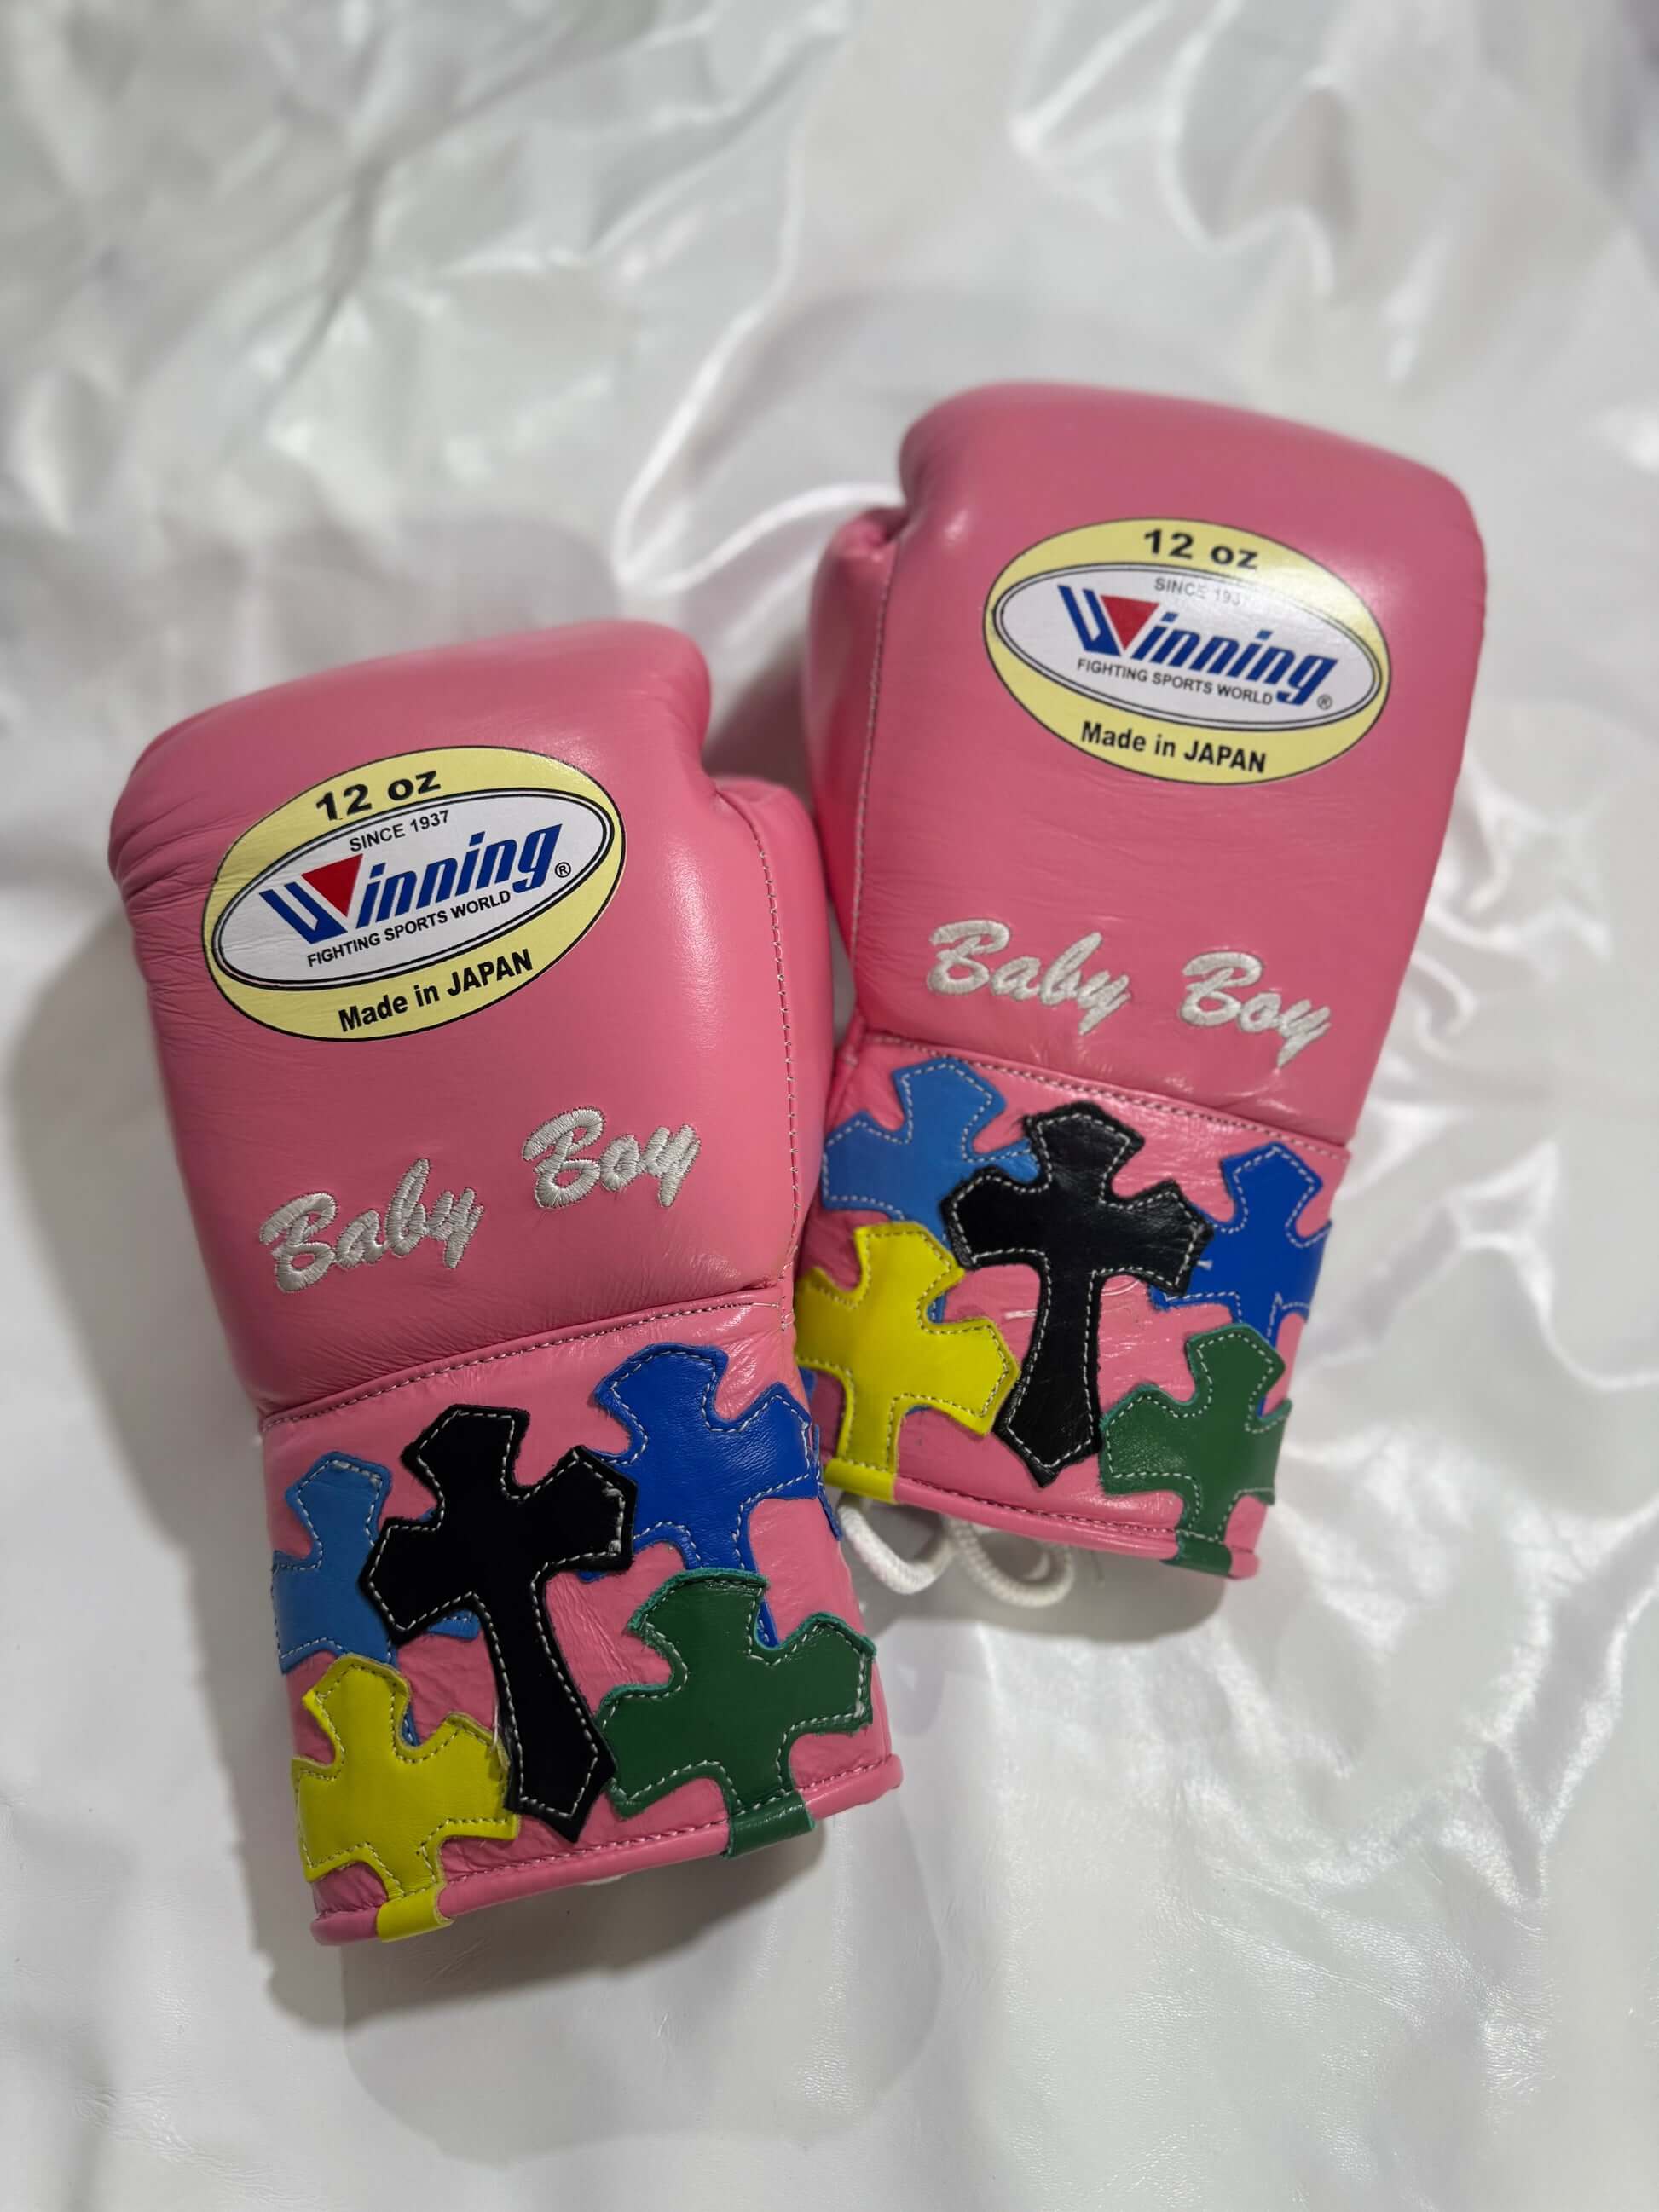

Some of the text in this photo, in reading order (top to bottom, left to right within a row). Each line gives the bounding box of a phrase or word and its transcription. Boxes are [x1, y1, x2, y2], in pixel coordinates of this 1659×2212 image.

[1144, 528, 1258, 570] 12 oz
[1154, 577, 1208, 599] SINCE
[1057, 585, 1338, 706] Winning
[1077, 658, 1274, 706] FIGHTING SPORTS WORLD
[1081, 720, 1267, 773] Made in JAPAN
[315, 770, 442, 821] 12 oz
[350, 810, 449, 852] SINCE 1937
[259, 823, 563, 944] Winning
[307, 890, 512, 968] FIGHTING SPORTS WORLD
[338, 949, 534, 1032] Made in JAPAN
[927, 919, 1331, 1068] Baby Boy
[259, 1106, 702, 1293] Baby Boy
